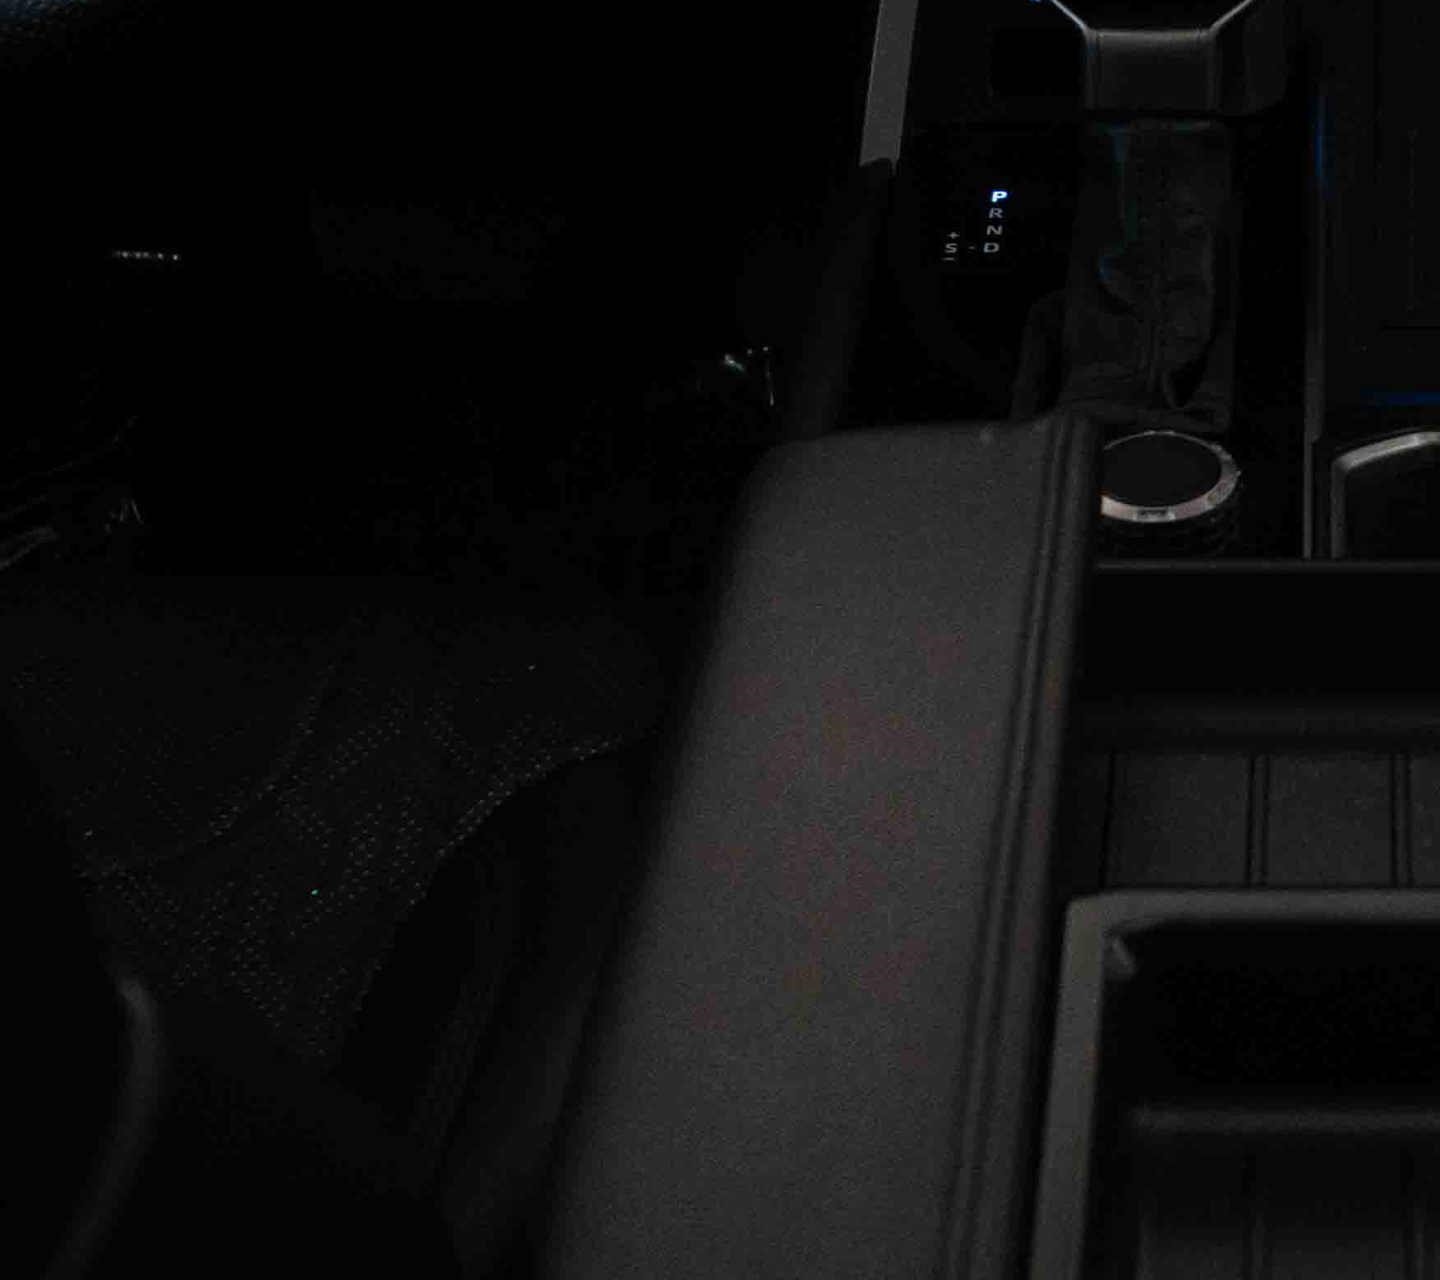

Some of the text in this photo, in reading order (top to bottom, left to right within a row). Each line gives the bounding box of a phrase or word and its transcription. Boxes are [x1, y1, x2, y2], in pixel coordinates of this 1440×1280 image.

[991, 189, 1009, 203] P
[988, 207, 1004, 219] R
[986, 224, 1004, 236] N
[944, 242, 959, 254] S
[983, 241, 1000, 254] D
